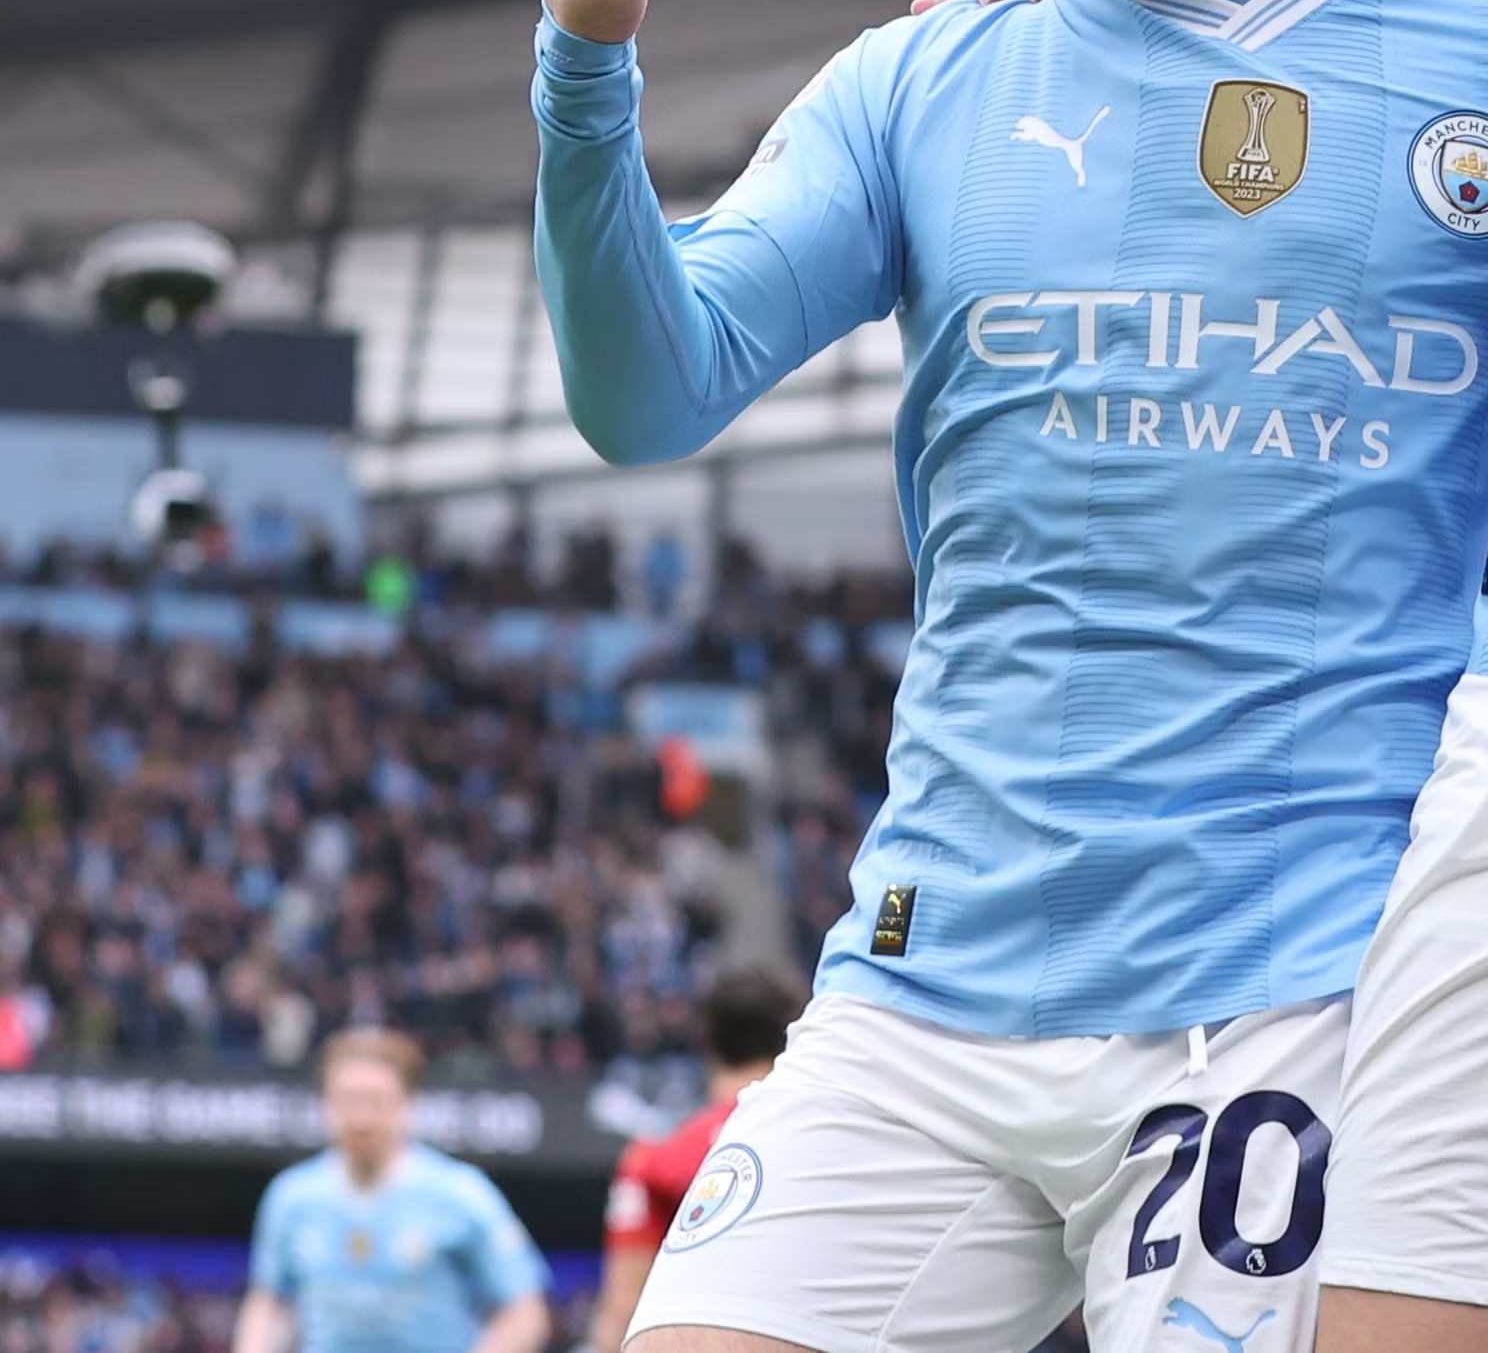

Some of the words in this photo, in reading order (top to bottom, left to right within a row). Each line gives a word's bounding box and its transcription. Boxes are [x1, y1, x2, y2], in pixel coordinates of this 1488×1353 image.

[1227, 163, 1275, 182] FIFA
[1233, 188, 1261, 200] 2023
[1447, 212, 1481, 231] CITY
[966, 290, 1479, 396] ETIHAD
[1039, 391, 1391, 470] AIRWAYS
[1126, 1089, 1333, 1280] 20
